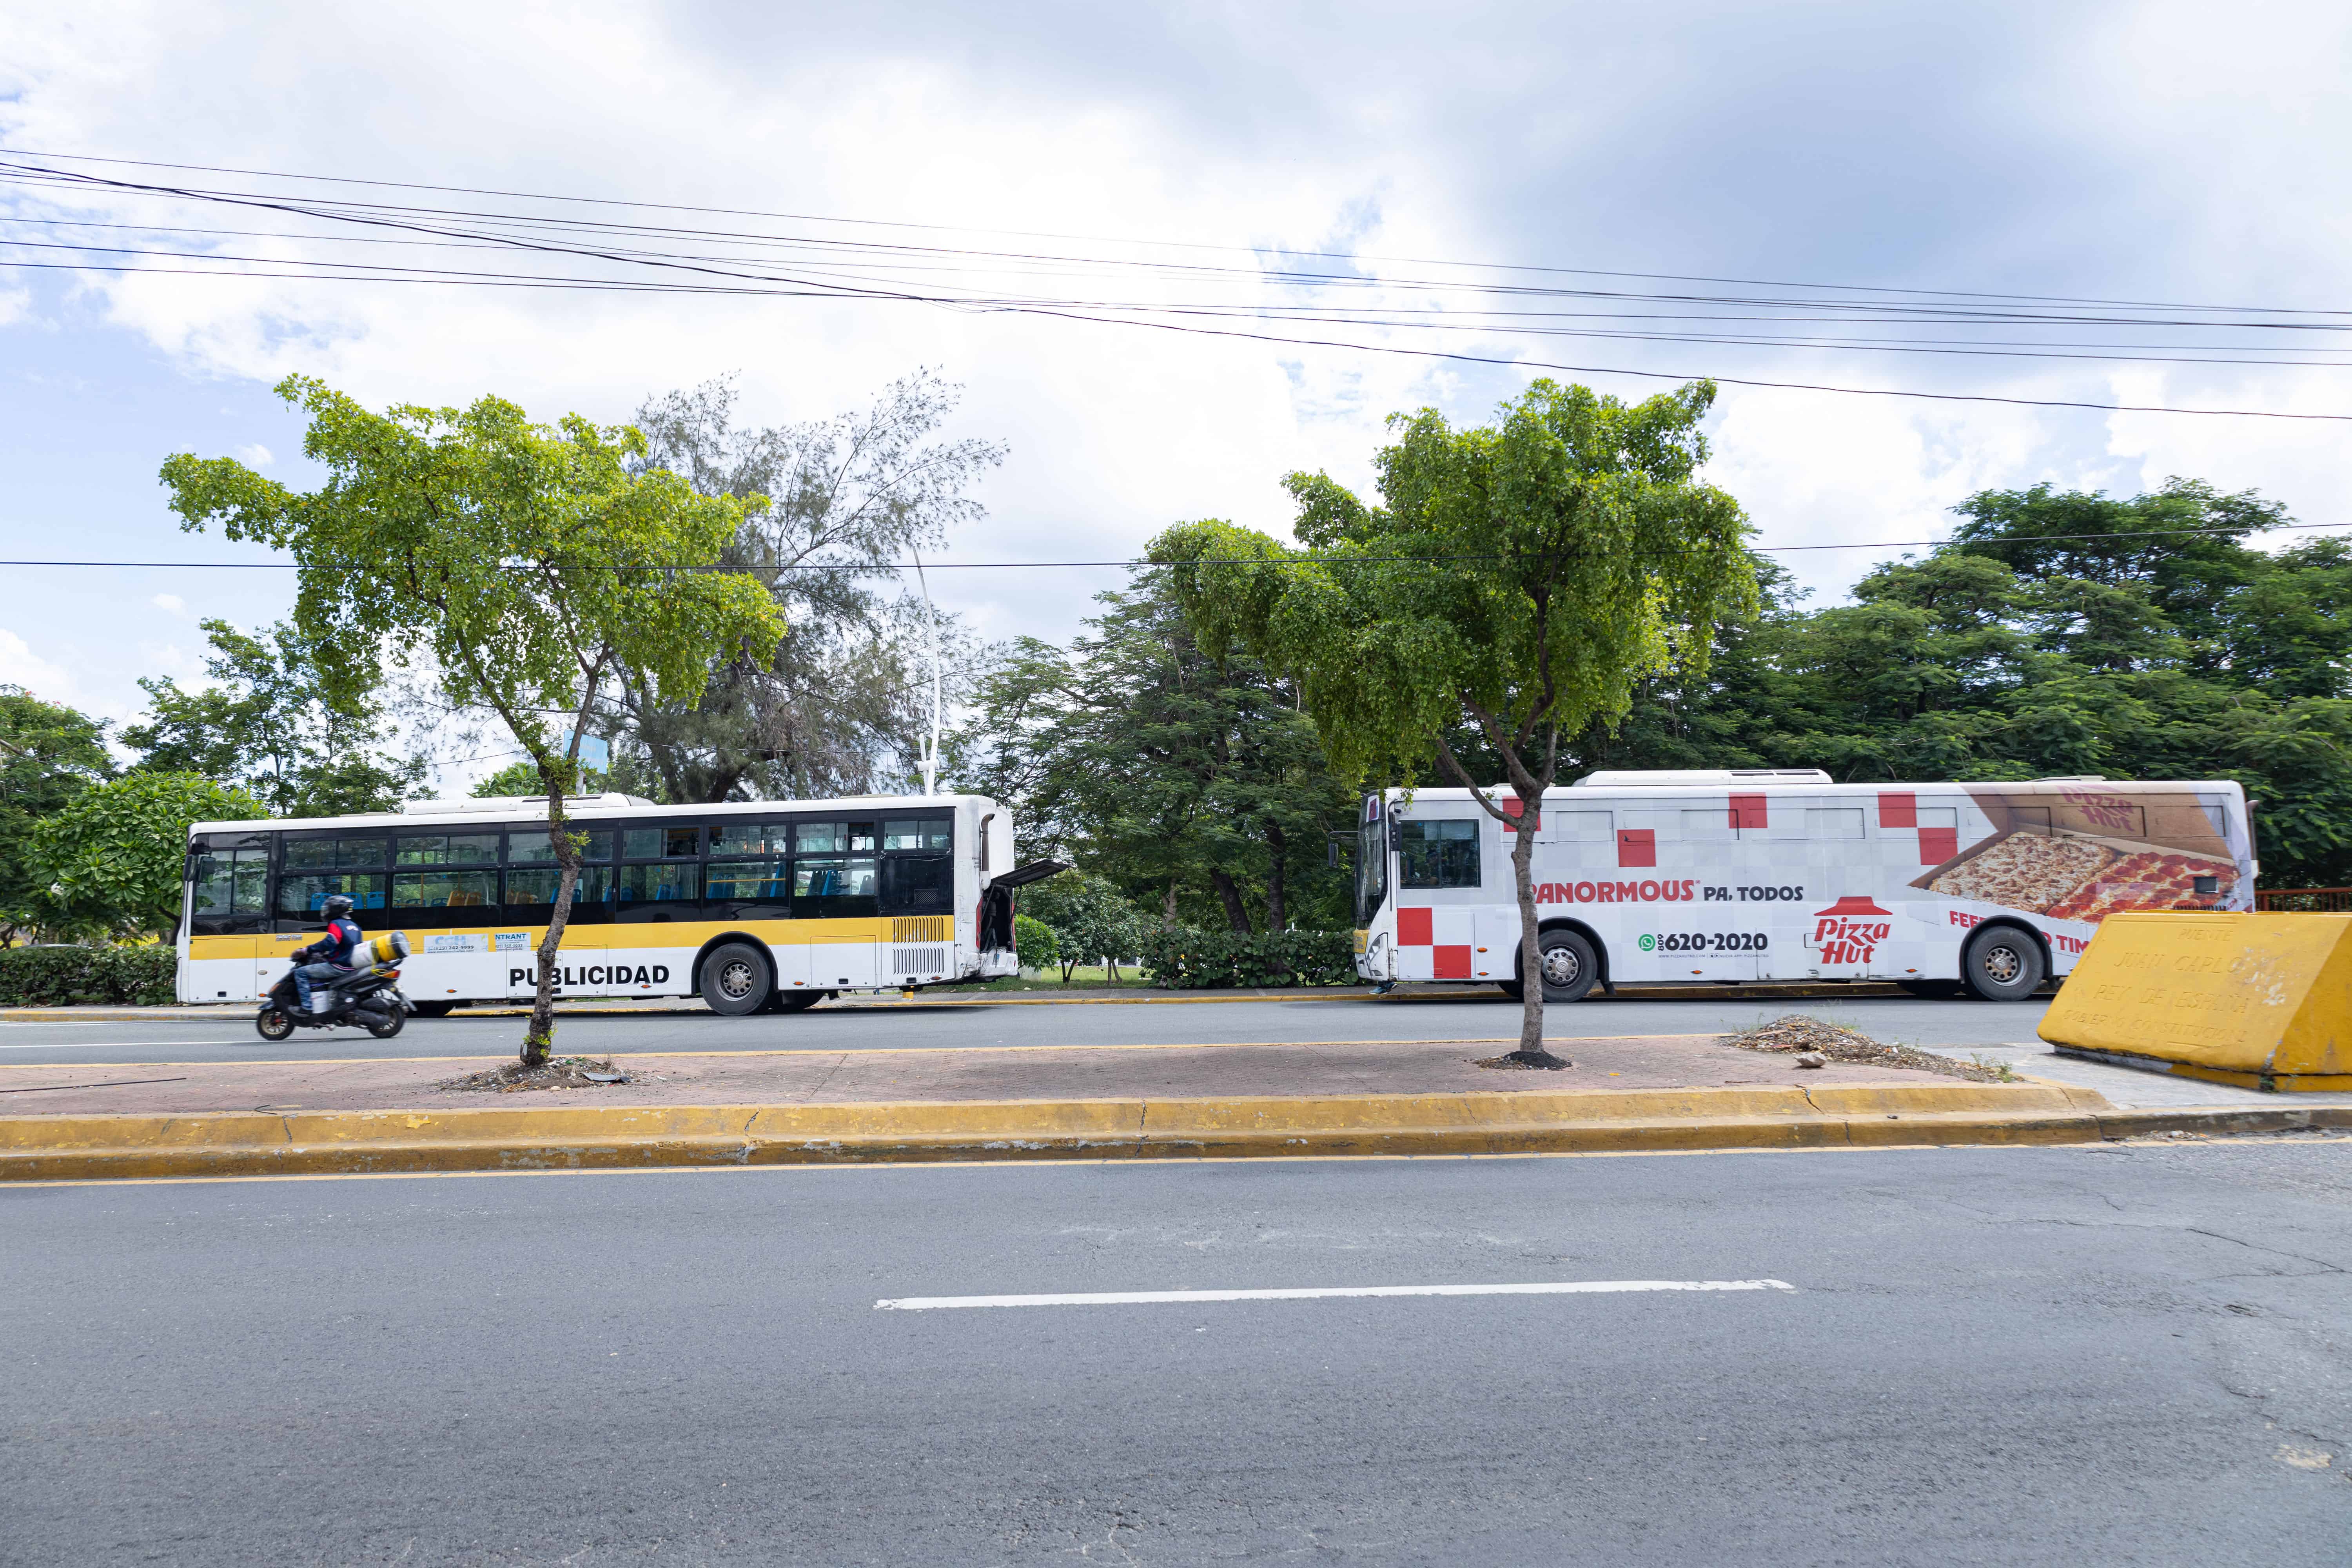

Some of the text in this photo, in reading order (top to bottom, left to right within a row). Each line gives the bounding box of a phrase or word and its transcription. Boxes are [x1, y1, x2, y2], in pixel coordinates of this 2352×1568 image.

[2078, 805, 2135, 831] Hut
[1737, 886, 1803, 901] TODOS
[1665, 933, 1768, 951] 620-2020
[1814, 917, 1891, 946] Pizza
[2176, 929, 2233, 941] PUENTE
[1819, 941, 1875, 964] Hut
[2113, 952, 2166, 969] JUAN
[510, 965, 670, 987] PUBLICIDAD
[2092, 984, 2133, 1001] REY
[2138, 988, 2168, 1005] DE
